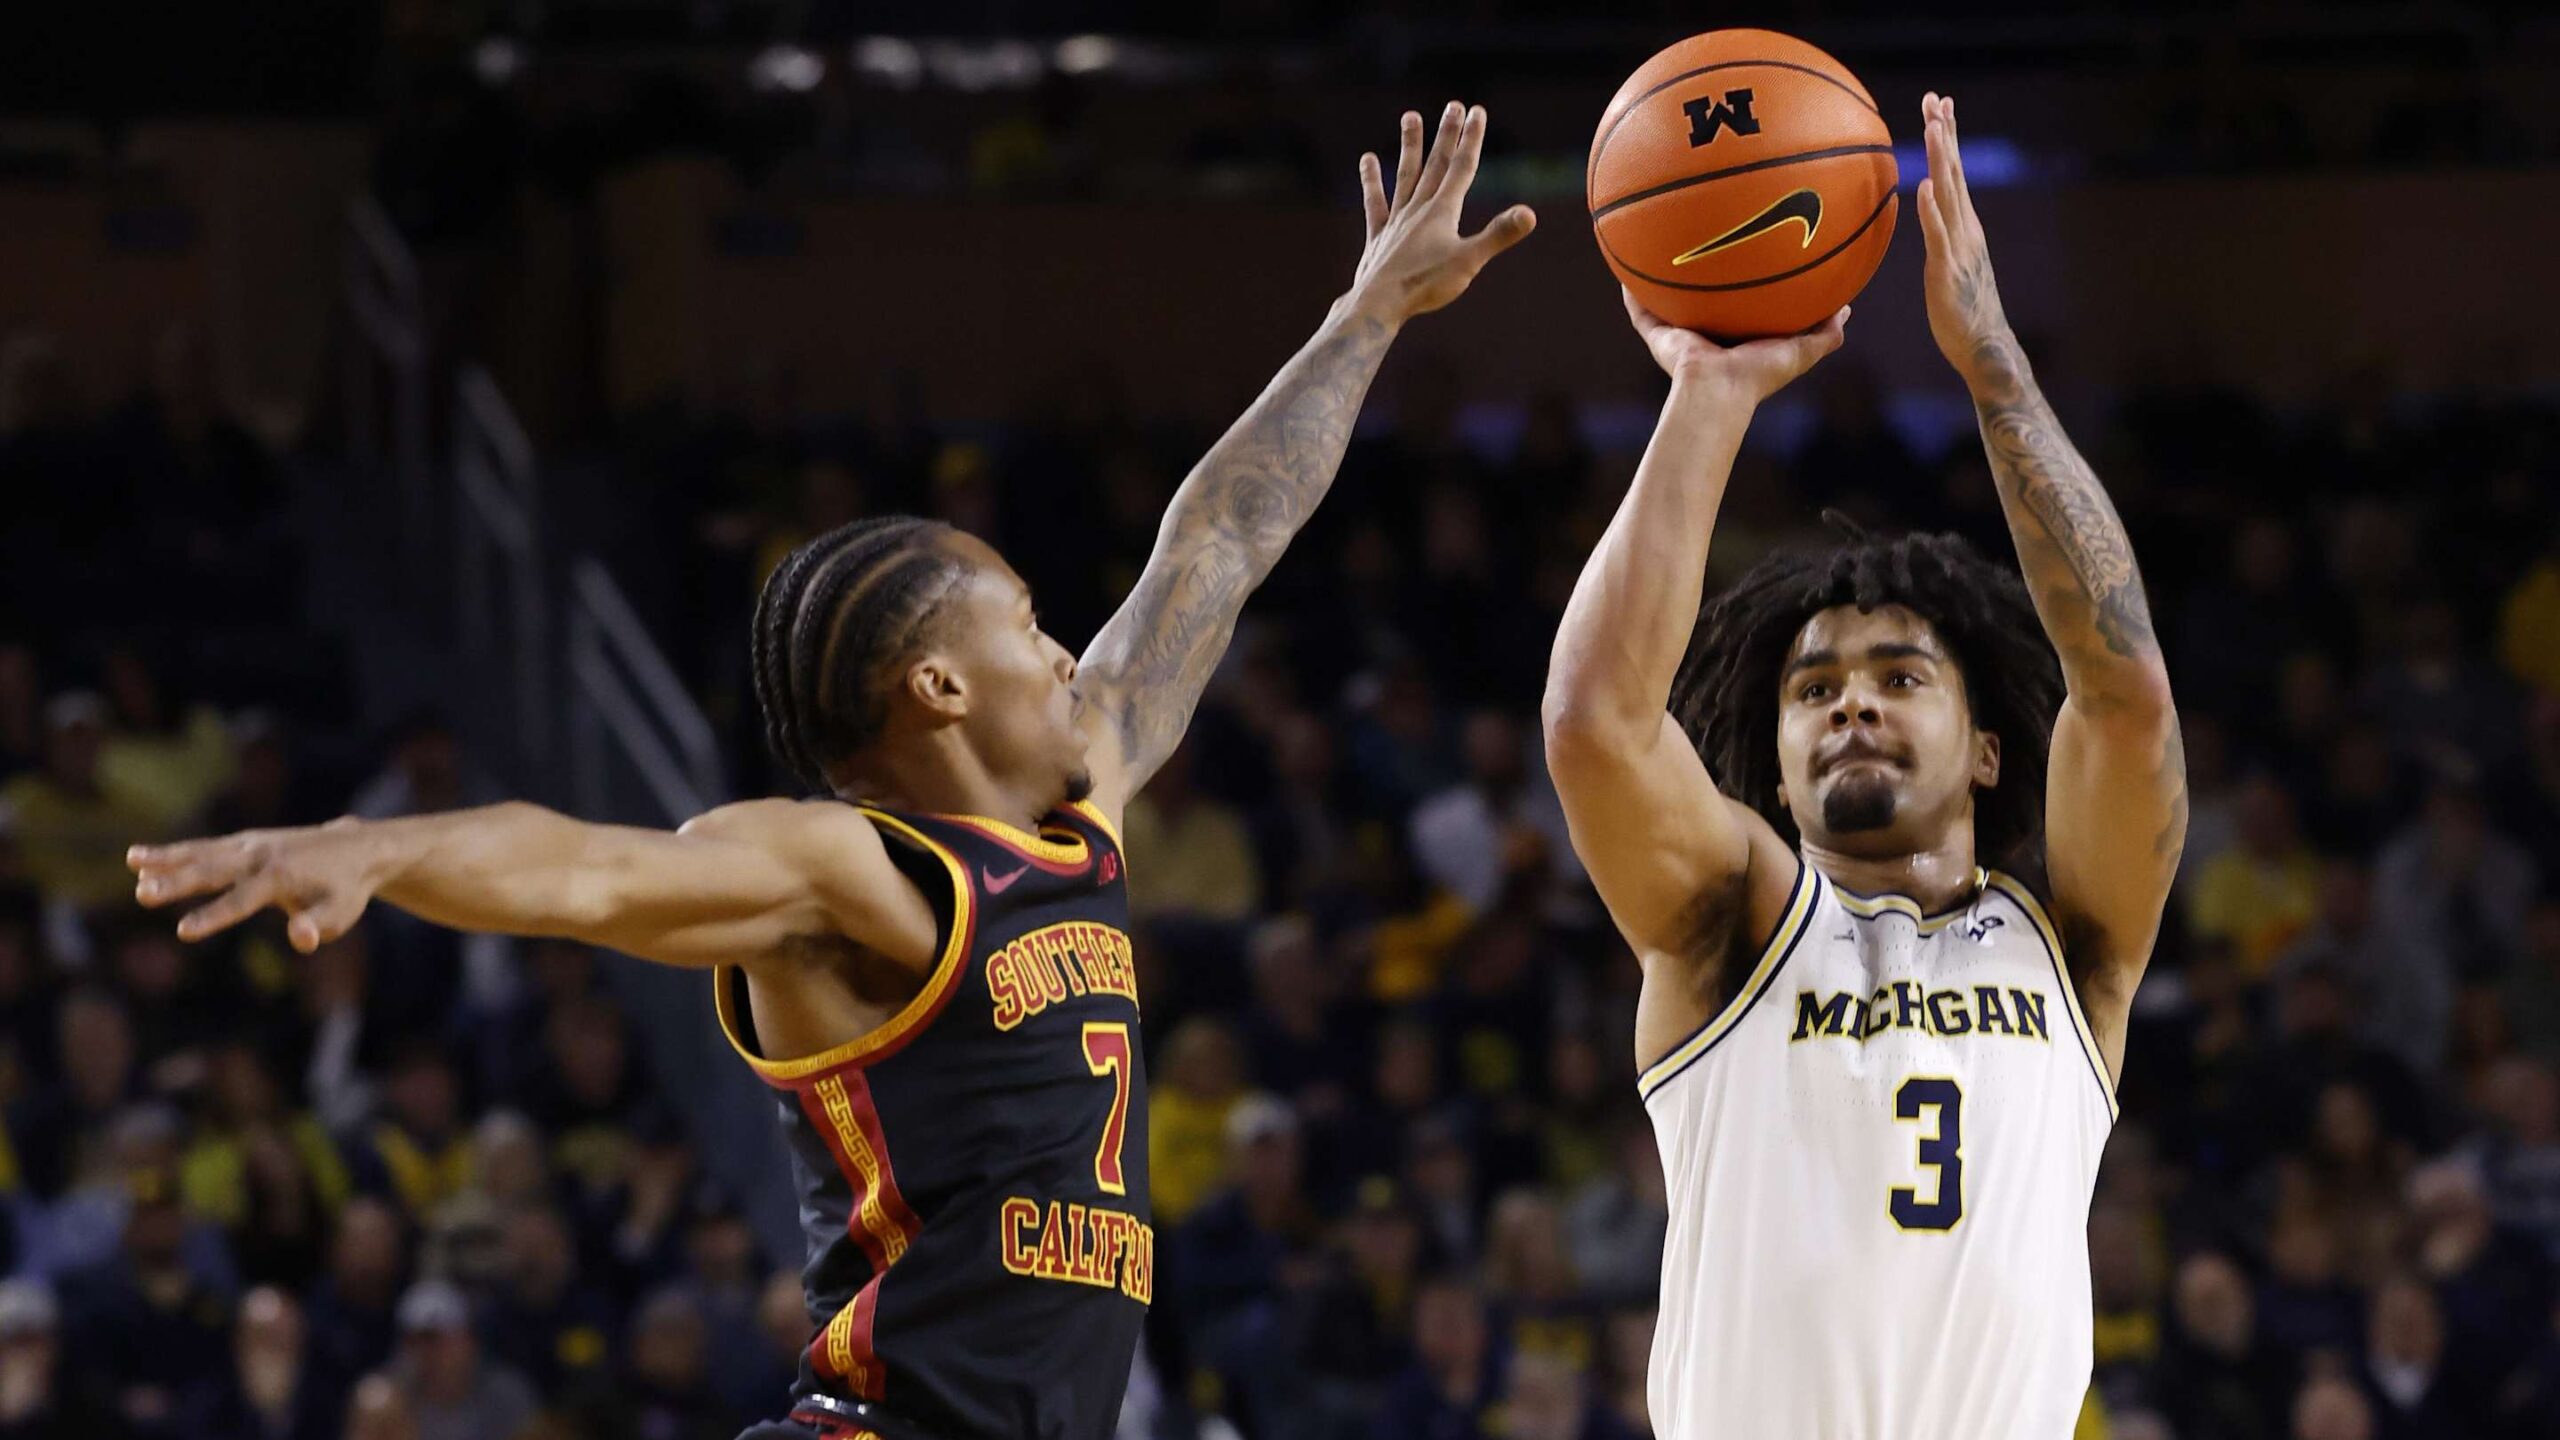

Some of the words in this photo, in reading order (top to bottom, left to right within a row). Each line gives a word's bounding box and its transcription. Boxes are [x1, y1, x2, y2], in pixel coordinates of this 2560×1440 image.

[986, 921, 1138, 1032] SOUTHER
[1082, 1022, 1131, 1196] 7
[1885, 1074, 1967, 1233] 3
